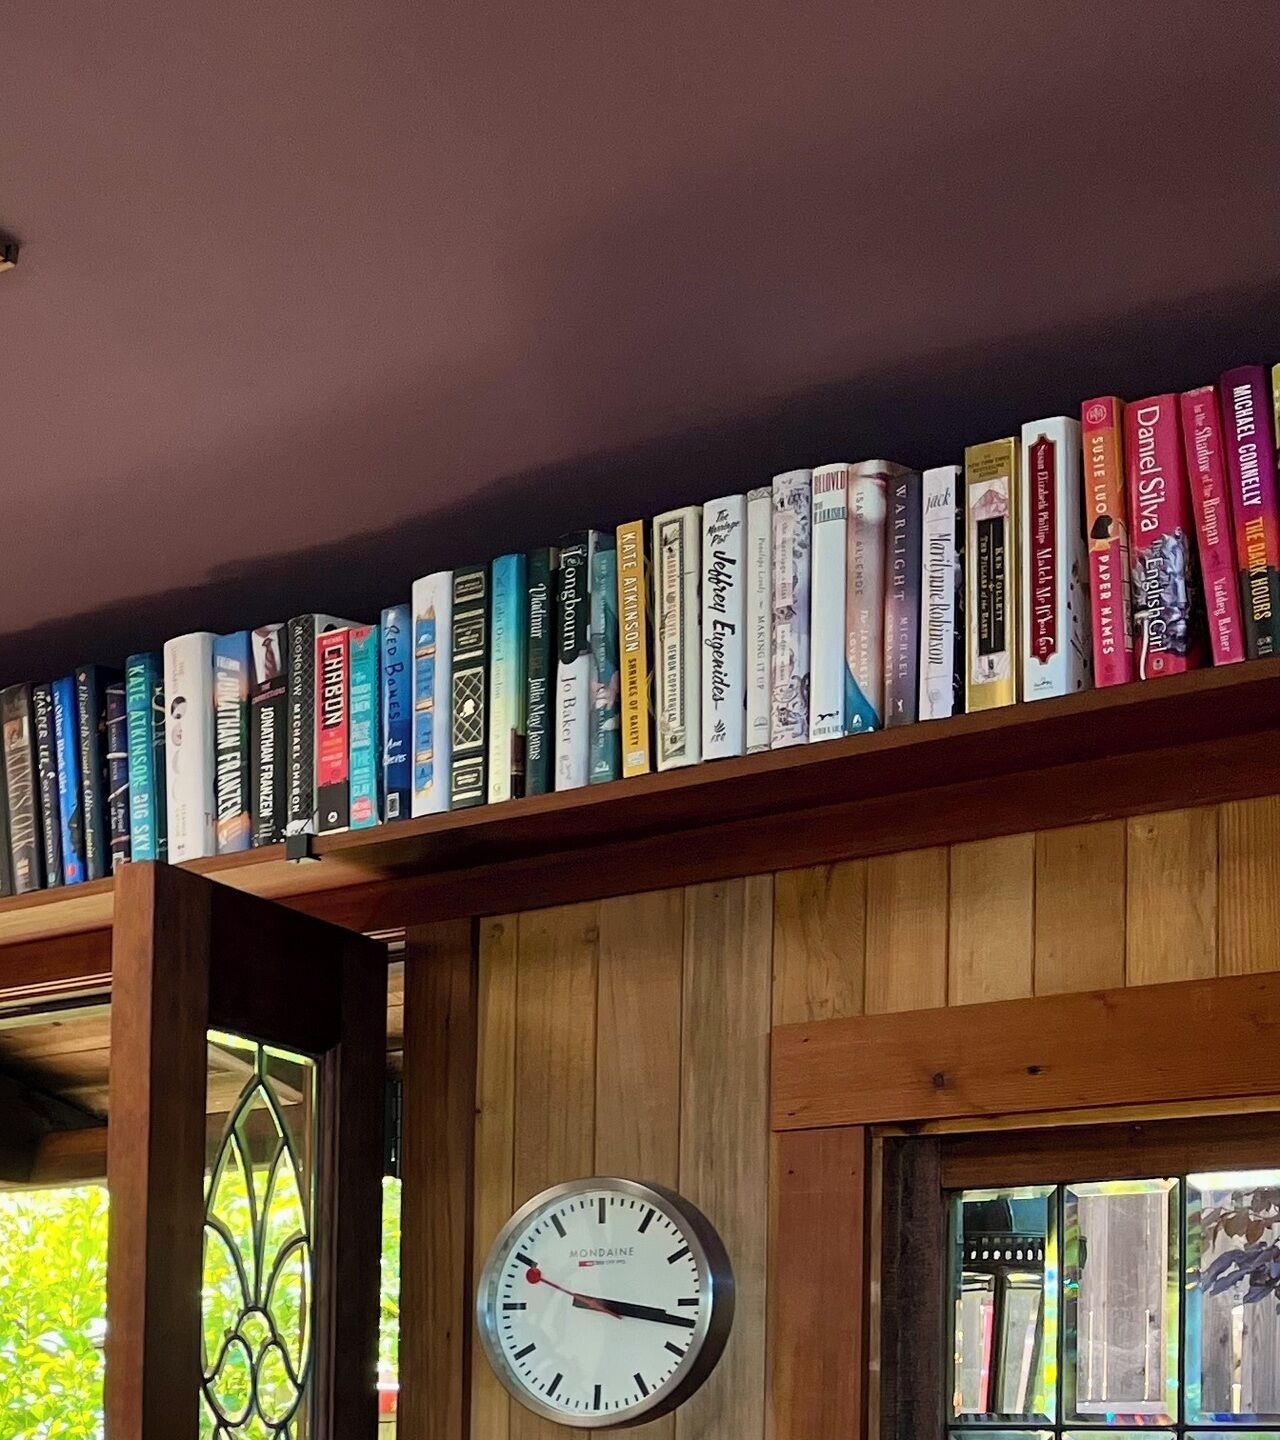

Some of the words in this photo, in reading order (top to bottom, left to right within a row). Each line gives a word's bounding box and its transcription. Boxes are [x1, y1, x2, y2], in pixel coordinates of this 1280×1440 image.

[1232, 383, 1256, 442] MICHAEL
[1091, 436, 1105, 478] SUSIE
[1136, 405, 1163, 477] Daniel
[1195, 425, 1217, 474] Shadow
[813, 470, 846, 495] BELOVED
[1037, 471, 1050, 511] Elizabeth
[1238, 443, 1263, 507] CONNELLY
[926, 487, 952, 515] jack
[1093, 484, 1108, 515] LUO
[1138, 477, 1168, 533] Silva
[1201, 497, 1223, 547] Banyan
[620, 530, 638, 571] KATE
[893, 484, 907, 603] WARLIGHT
[980, 535, 989, 554] THE
[1035, 511, 1050, 545] Phillips
[1244, 516, 1264, 542] THE
[706, 549, 737, 613] Jeffrey
[854, 540, 865, 597] ALLENDE
[924, 533, 952, 605] Marilynne
[994, 546, 1004, 572] KEN
[1036, 547, 1053, 585] Match
[1097, 554, 1111, 601] PAPER
[1246, 542, 1266, 575] DARK
[559, 545, 586, 652] Longbourn
[994, 573, 1005, 623] FOLLETT
[1143, 557, 1166, 618] English
[1211, 577, 1230, 617] Vaddey
[1250, 576, 1272, 621] HOURS
[528, 583, 548, 639] Vladimir
[622, 576, 641, 654] ATKINSON
[980, 611, 990, 640] EARTH
[1100, 606, 1115, 656] NAMES
[383, 624, 400, 657] RED
[756, 615, 766, 660] MAKING
[898, 615, 909, 680] MICHAEL
[927, 604, 952, 665] Robinson
[1147, 618, 1169, 654] Girl
[1216, 618, 1233, 654] Ratner
[626, 657, 639, 697] SHRINES
[666, 644, 678, 672] DEMON
[704, 619, 737, 704] Eugenides
[756, 663, 766, 674] IT
[127, 664, 146, 702] KATE
[323, 645, 345, 727] CHABON
[384, 661, 405, 721] BONES
[528, 677, 546, 703] Julia
[561, 675, 577, 693] Jo
[627, 699, 639, 710] OF
[665, 674, 679, 723] COPPERHEAD
[756, 676, 766, 690] UP
[216, 672, 241, 751] JONATHAN
[291, 703, 301, 759] MICHAEL
[527, 703, 547, 729] May
[561, 697, 578, 744] Baker
[628, 714, 639, 746] GAIETY
[129, 709, 149, 788] ATKINSON
[259, 706, 274, 766] JONATHAN
[528, 727, 547, 761] Jonas
[132, 793, 149, 819] BIG
[217, 752, 242, 822] FRANZEN
[259, 764, 275, 819] FRANZEN
[291, 763, 301, 814] CHABON
[12, 813, 36, 854] OAK
[133, 825, 151, 852] SKY
[569, 1247, 634, 1258] MONDAINE
